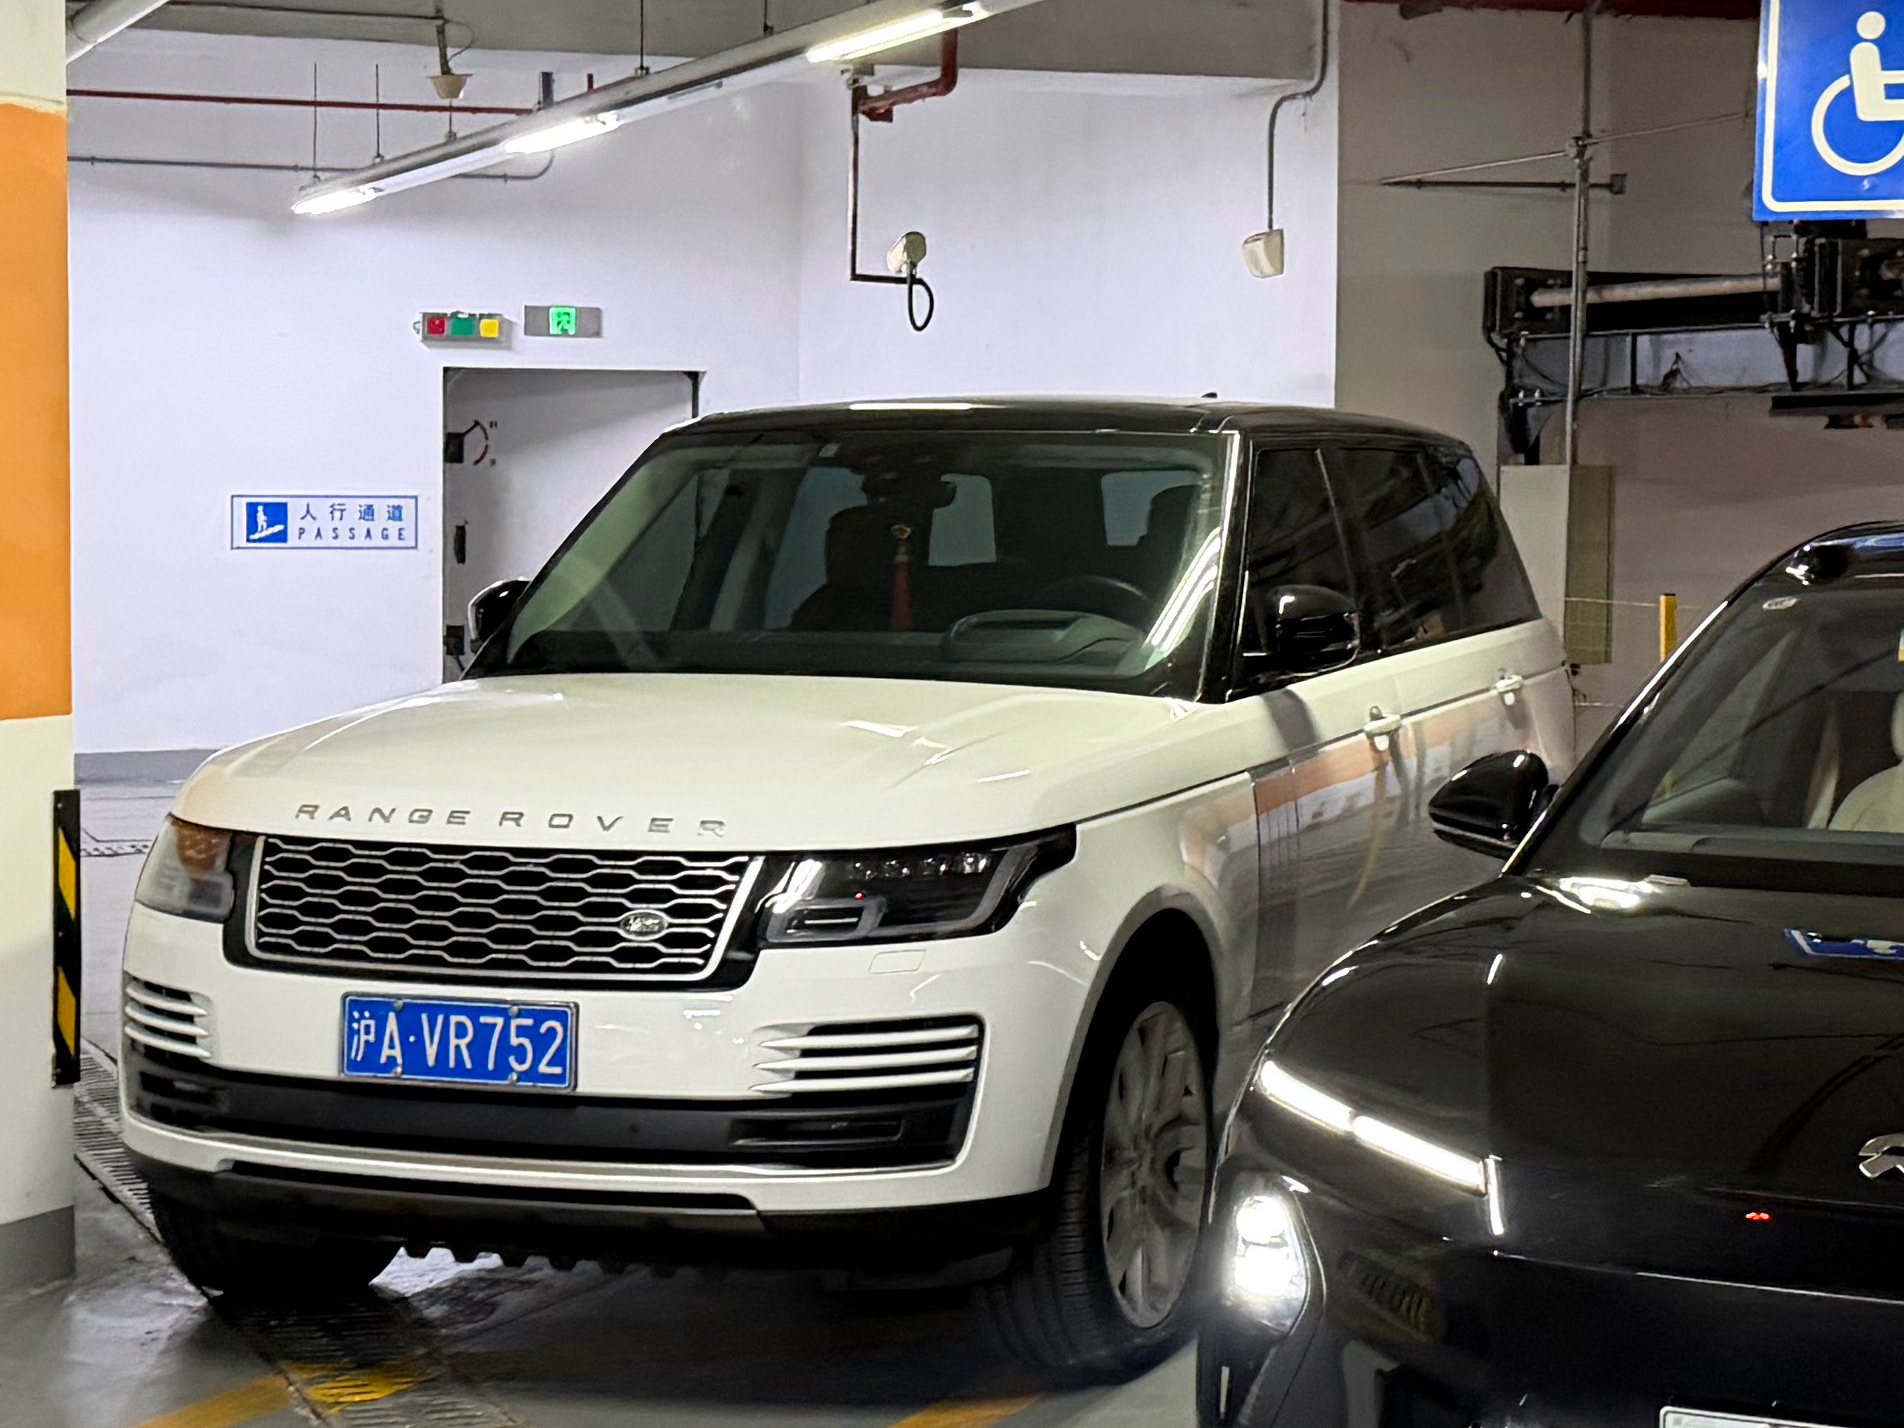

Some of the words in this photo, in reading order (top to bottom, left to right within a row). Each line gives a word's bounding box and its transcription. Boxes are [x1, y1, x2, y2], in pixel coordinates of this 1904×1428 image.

[299, 502, 404, 522] 人行通道
[298, 527, 406, 541] PASSAGE
[295, 803, 471, 825] RANGE
[498, 810, 727, 838] ROVER
